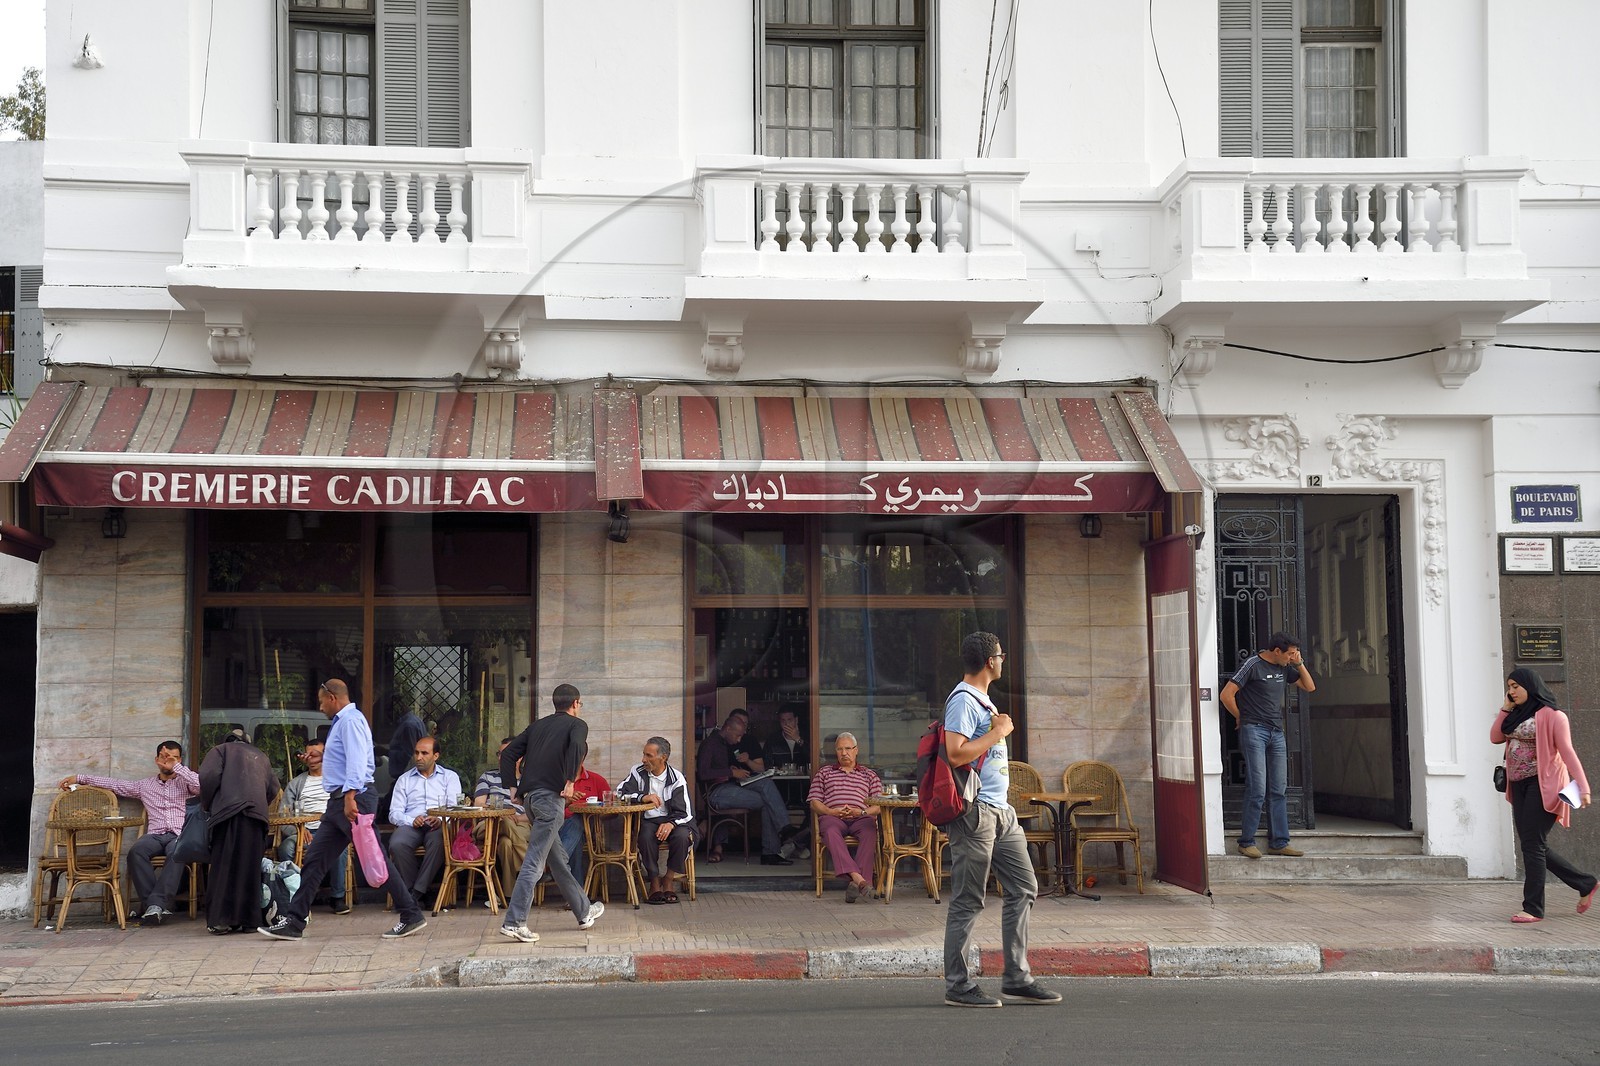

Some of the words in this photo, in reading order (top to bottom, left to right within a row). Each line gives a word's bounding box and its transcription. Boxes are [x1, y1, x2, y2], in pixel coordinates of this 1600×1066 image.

[111, 470, 312, 504] CREMERIE
[326, 475, 525, 506] CADILLAC
[713, 473, 879, 511] كادياك
[882, 473, 1094, 512] كريمري
[1308, 475, 1320, 487] 12
[1515, 492, 1577, 502] BOULEVARD
[1520, 507, 1535, 517] DE
[1540, 506, 1573, 516] PARIS
